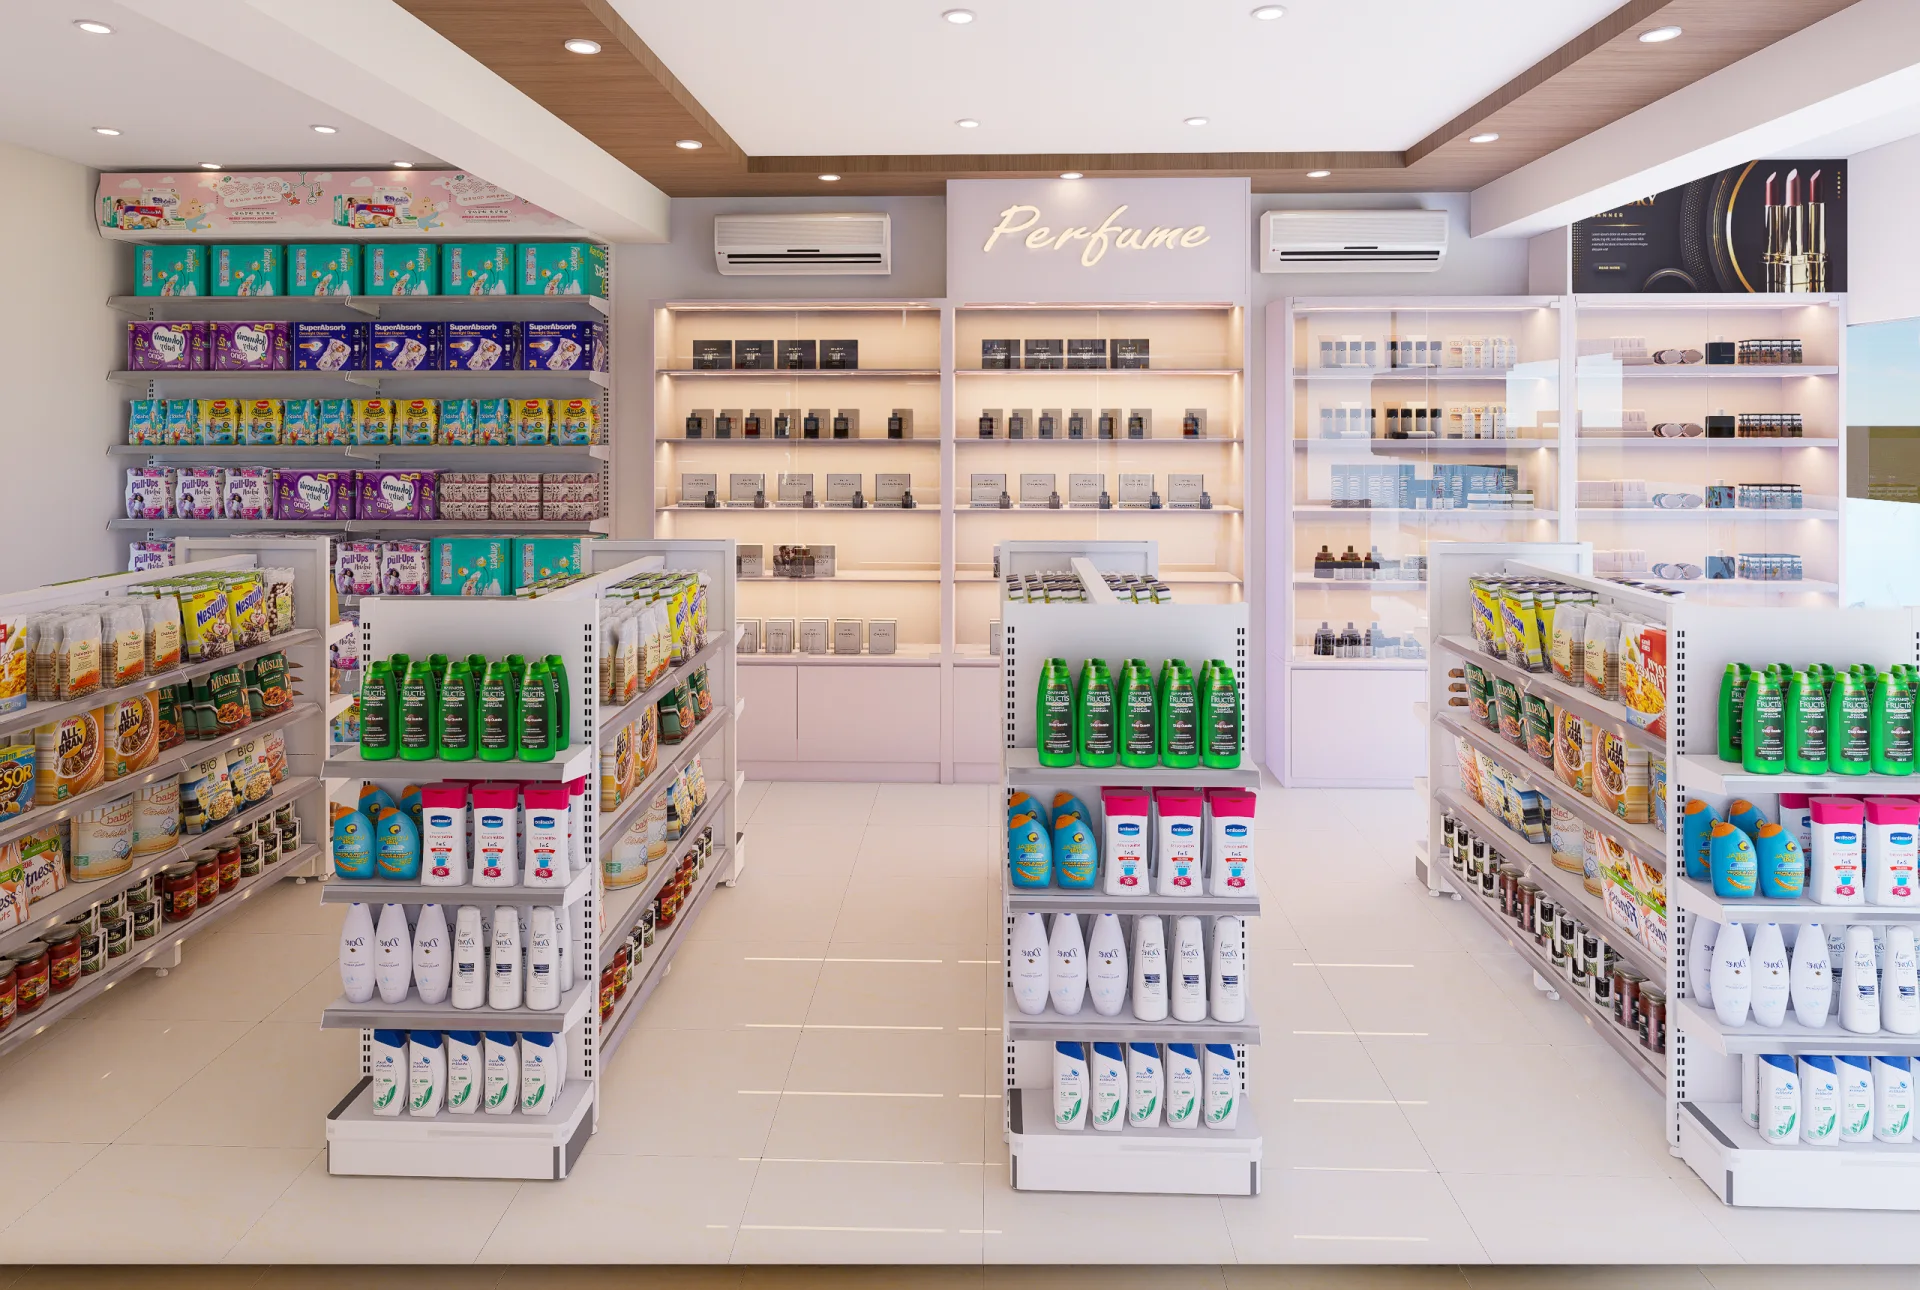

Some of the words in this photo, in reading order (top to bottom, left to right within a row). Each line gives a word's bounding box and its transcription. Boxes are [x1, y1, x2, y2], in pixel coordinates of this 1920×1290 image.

[983, 204, 1211, 267] Perfume
[299, 324, 346, 332] SuperAbsorb
[375, 324, 422, 332] SuperAbsorb
[450, 323, 497, 331] SuperAbsorb
[529, 323, 577, 331] SuperAbsorb
[132, 479, 159, 493] Pull-Ups
[182, 479, 209, 493] Pull-Ups
[230, 479, 257, 493] Pull-Ups
[341, 553, 368, 569] Pull-Ups
[387, 553, 415, 569] Pull-Ups
[236, 586, 263, 617] Nesquik
[196, 593, 227, 627] Nesquik
[158, 689, 173, 700] LIX
[1756, 700, 1781, 708] FRUCTIS
[1842, 701, 1868, 709] FRUCTIS
[120, 708, 139, 724] ALL-
[61, 726, 83, 744] ALL-
[118, 716, 140, 738] BRAN
[58, 735, 83, 758] BRAN
[23, 861, 55, 888] tness
[0, 892, 17, 912] ess
